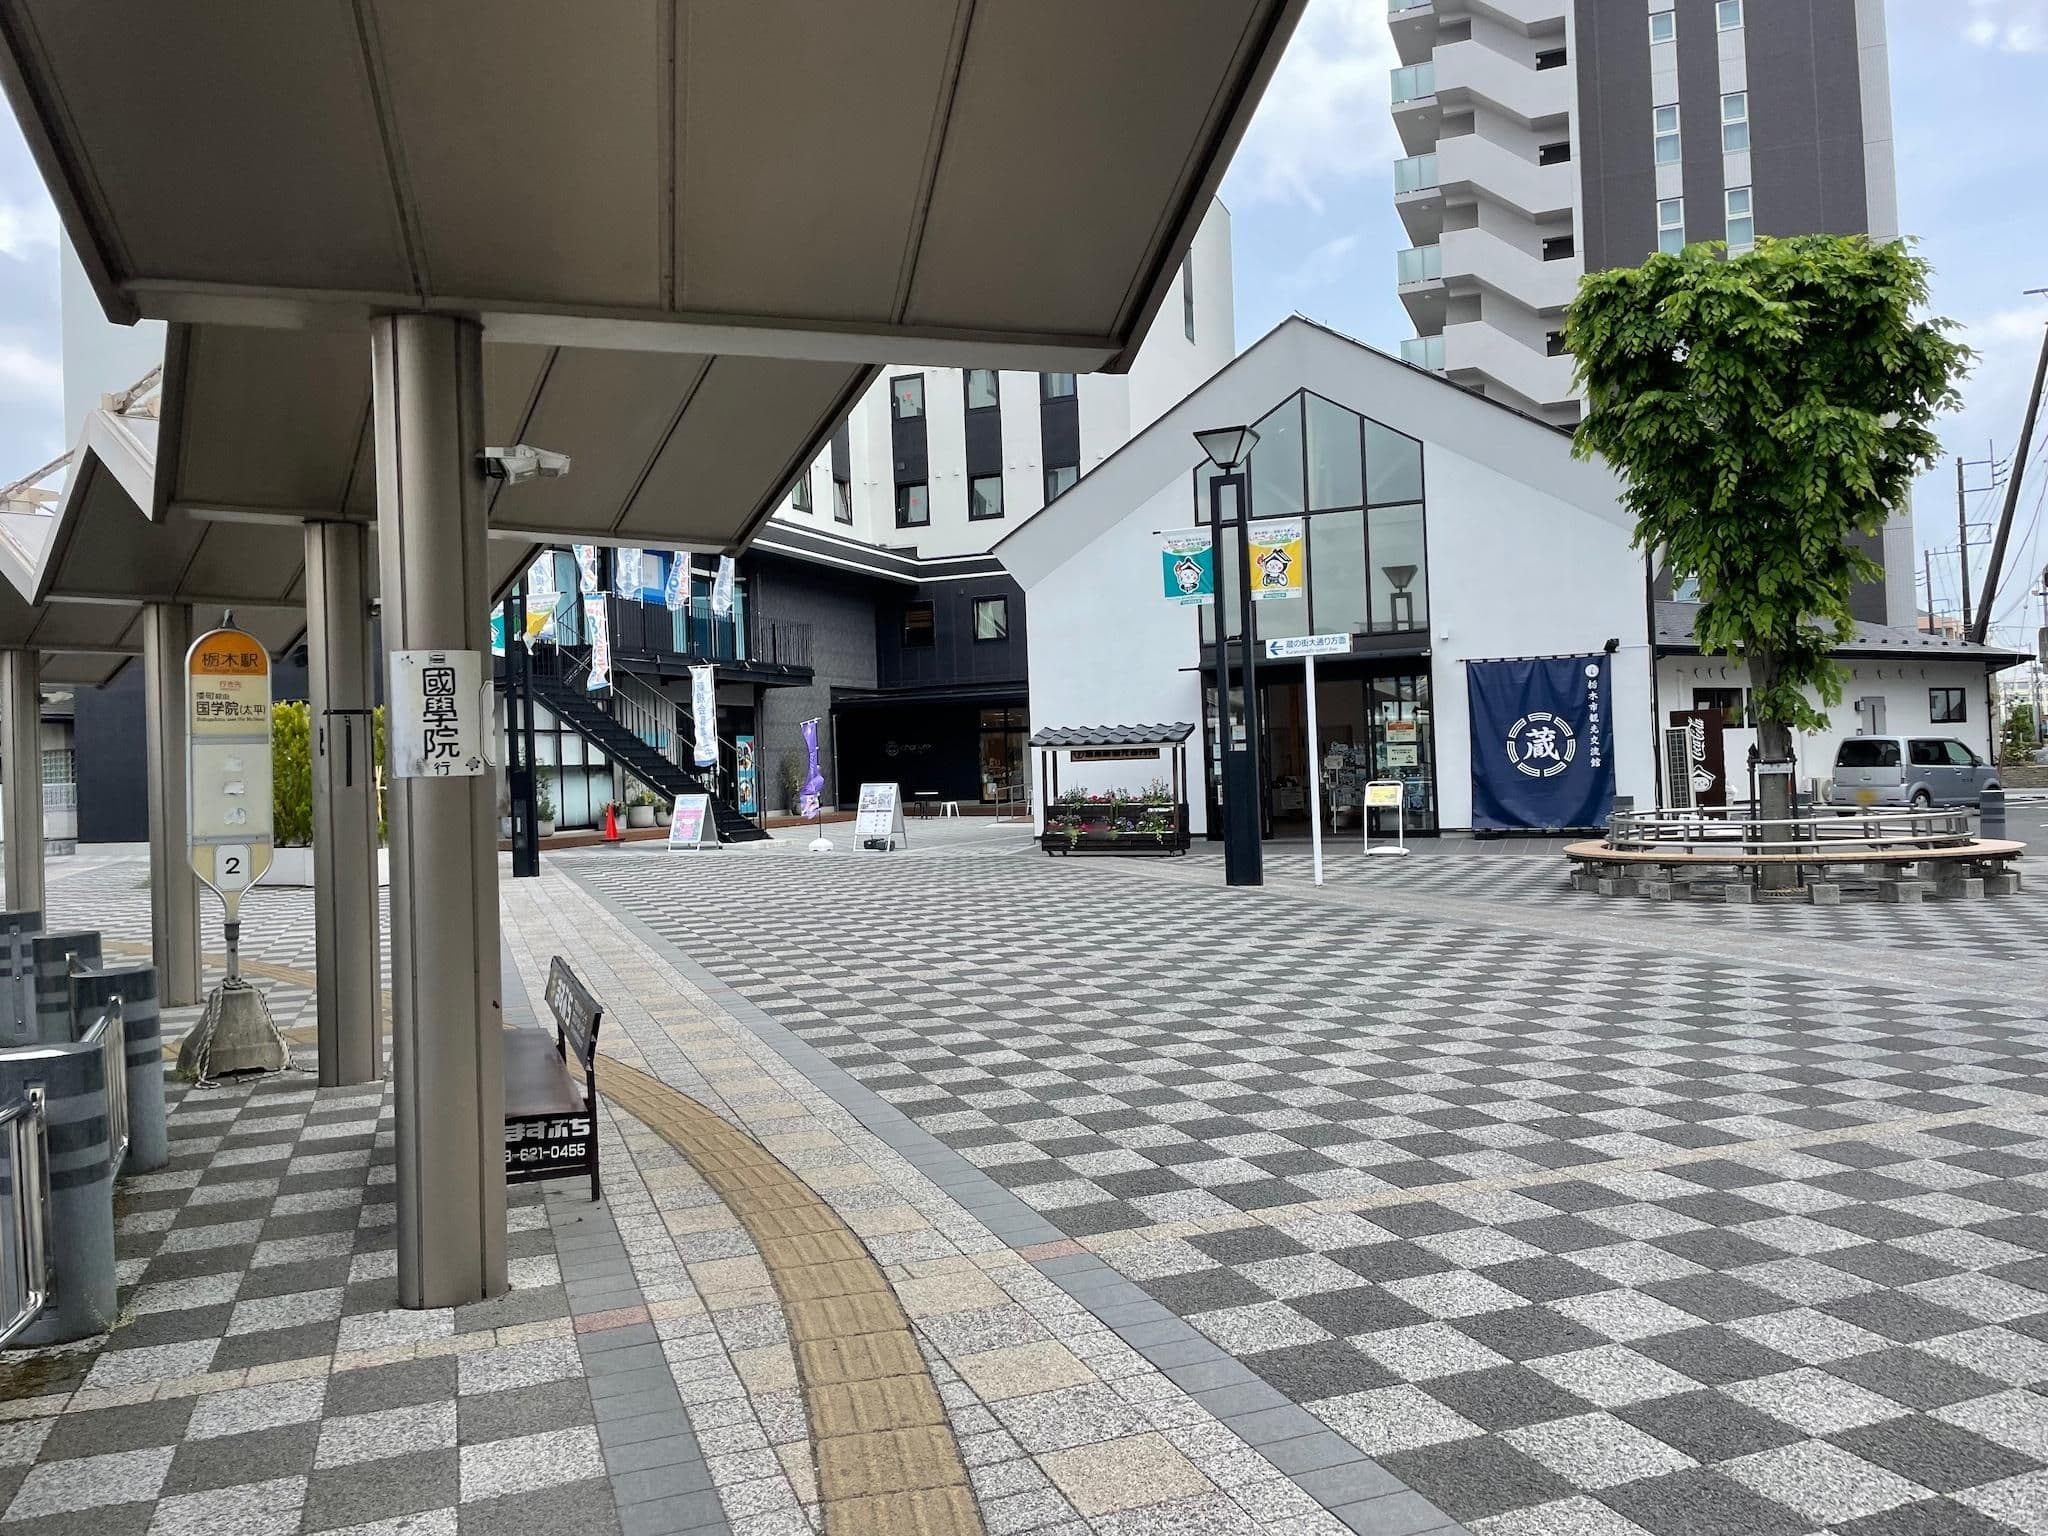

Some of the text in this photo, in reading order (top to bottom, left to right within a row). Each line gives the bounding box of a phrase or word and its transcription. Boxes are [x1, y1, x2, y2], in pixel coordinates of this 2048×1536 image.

[202, 652, 258, 667] 栃木駅
[196, 700, 266, 716] 国学院(太平)
[1523, 726, 1560, 760] 蔵
[225, 857, 241, 874] 2
